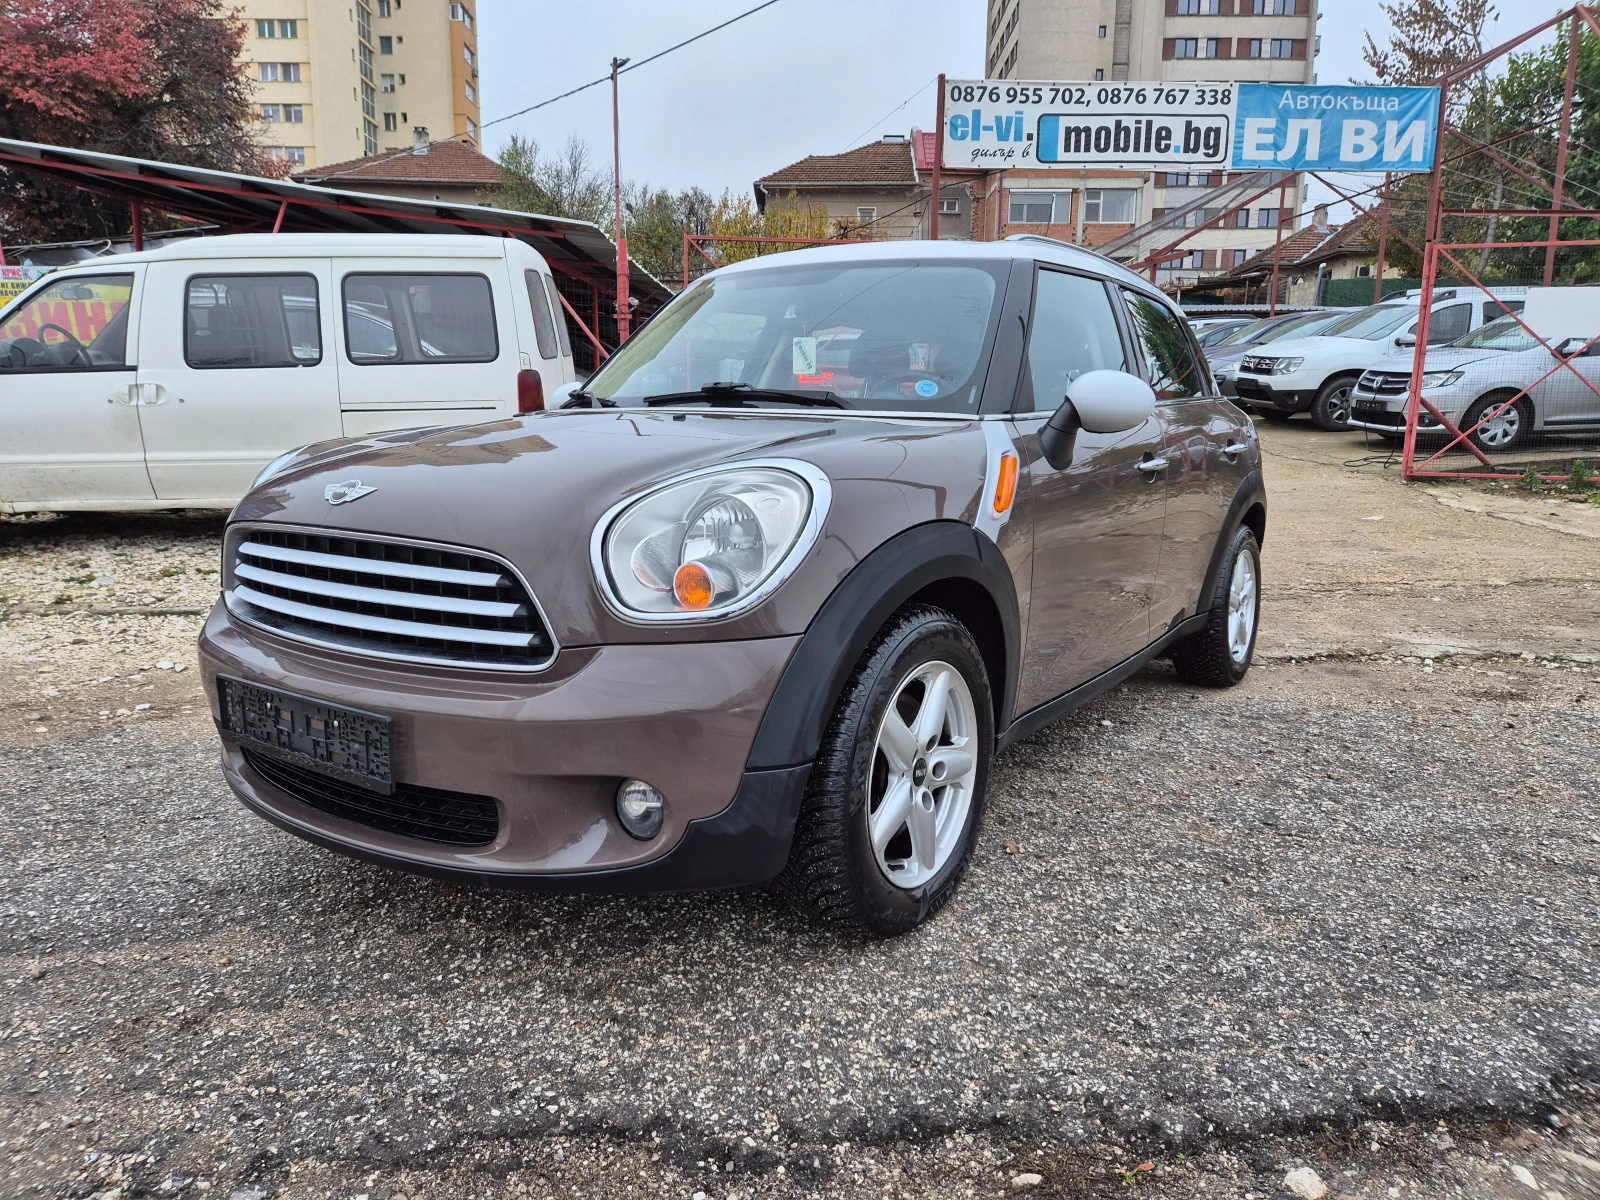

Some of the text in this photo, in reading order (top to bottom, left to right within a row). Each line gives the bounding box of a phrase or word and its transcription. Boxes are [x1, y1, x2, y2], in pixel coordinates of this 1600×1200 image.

[950, 85, 1232, 107] 0876 955 702, 0876 767 338
[1278, 89, 1399, 115] Автокъща
[1063, 119, 1222, 158] mobile.bg
[1241, 117, 1426, 163] ЕЛ ВИ
